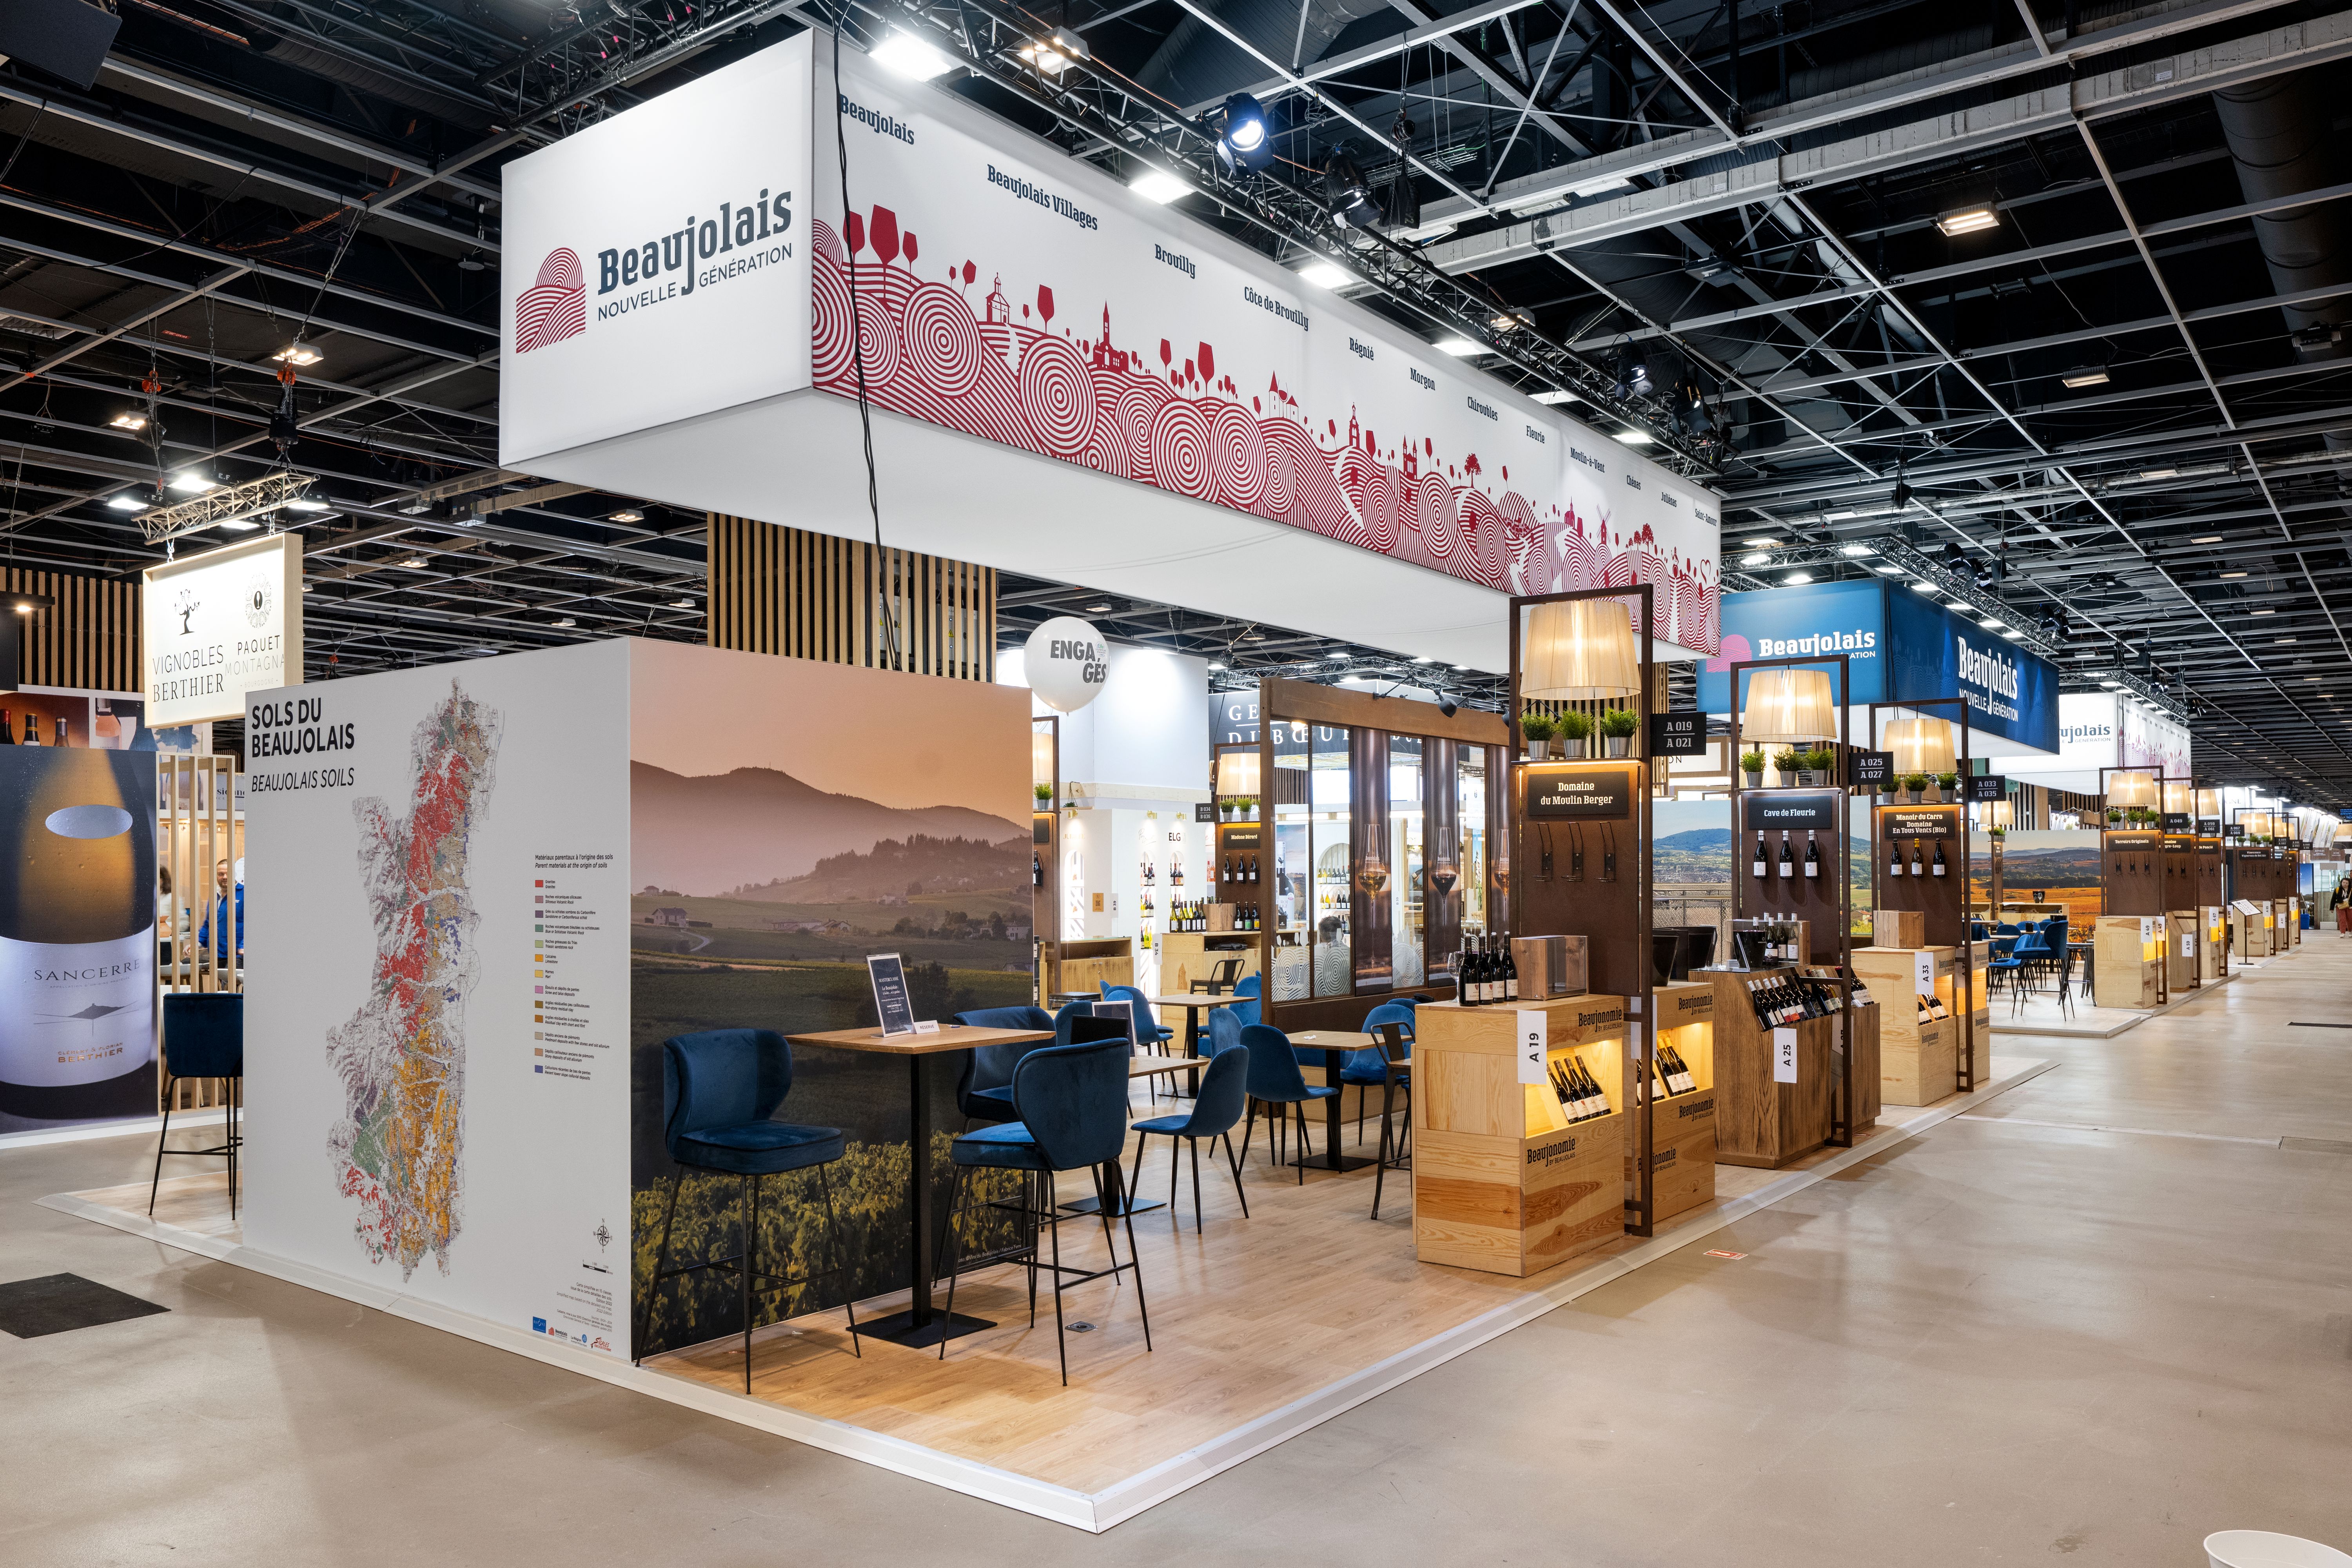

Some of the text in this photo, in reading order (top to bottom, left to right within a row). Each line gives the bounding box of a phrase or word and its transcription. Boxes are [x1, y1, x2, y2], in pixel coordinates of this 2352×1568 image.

[840, 93, 915, 145] Beaujolais
[987, 164, 1098, 230] Beaujolais Villages
[598, 188, 792, 296] Beaujolais
[1155, 243, 1196, 280] Brouilly
[598, 242, 792, 321] NOUVELLE GÉNÉRATION
[1244, 287, 1309, 332] Côte de Brouilly
[1349, 336, 1374, 361] Régnié
[1410, 367, 1436, 391] Morgon
[1468, 396, 1498, 421] Chiroubles
[1526, 425, 1545, 444] Fleurie
[1570, 446, 1605, 474] Moulin-à-Vent
[1626, 474, 1641, 490] Chénas
[1661, 492, 1677, 508] Juliénas
[1695, 508, 1717, 527] Saint-Amour
[238, 635, 280, 655] PAQUET
[1050, 639, 1095, 662] ENGA
[1759, 629, 1875, 657] Beaujolais
[153, 645, 224, 675] VIGNOBLES
[1082, 657, 1107, 684] GÉS
[244, 678, 274, 688] BOURGOGNE
[1958, 635, 2018, 715] Beaujolais
[153, 673, 224, 702] BERTHIER
[252, 697, 322, 730] SOLS DU
[1959, 688, 2018, 722] NOUVELLE GÉNÉRATION
[1666, 721, 1692, 731] A 019
[2060, 724, 2111, 744] ujolais
[252, 723, 355, 758] BEAUJOLAIS
[1666, 738, 1692, 748] A 021
[1860, 758, 1882, 767] A 025
[252, 767, 355, 793] BEAUJOLAIS SOILS
[1558, 782, 1595, 791] Domaine
[1541, 795, 1613, 806] du Moulin Berger
[1169, 832, 1181, 842] ELG
[34, 959, 140, 981] SANCERRE
[1923, 965, 1929, 975] 33
[1679, 993, 1713, 1015] Beaujonomie
[1578, 1006, 1622, 1033] Beaujonomie
[1603, 1022, 1622, 1031] BEAUJOLAIS
[58, 1047, 123, 1063] BERTHIER
[98, 1042, 123, 1051] FLORIAN
[1529, 1033, 1539, 1063] A 19
[1783, 1044, 1791, 1056] 25
[1679, 1096, 1713, 1122] Beaujonomie
[1698, 1110, 1713, 1119] BEAUJOLAIS
[1527, 1136, 1575, 1167] Beaujonomie
[1555, 1152, 1575, 1163] BEAUJOLAIS
